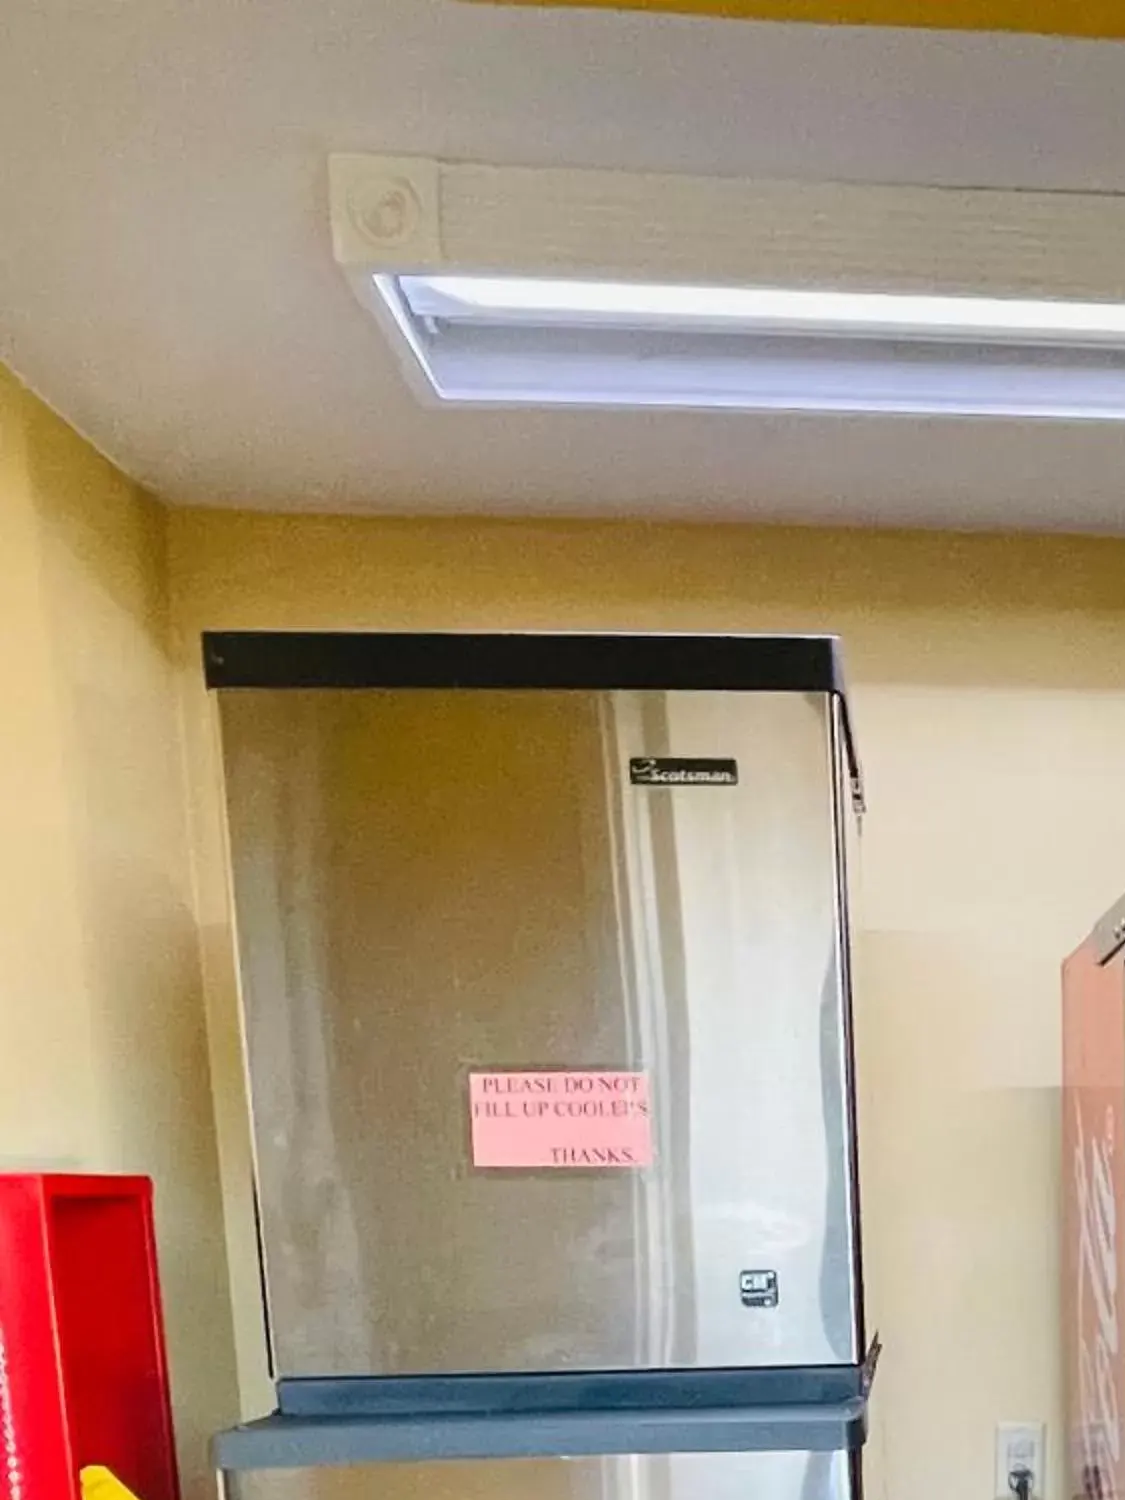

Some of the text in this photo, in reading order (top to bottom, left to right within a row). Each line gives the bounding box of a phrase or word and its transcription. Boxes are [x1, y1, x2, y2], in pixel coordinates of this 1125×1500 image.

[482, 1075, 641, 1094] PLEASE DO NOT
[474, 1101, 519, 1120] FILL
[522, 1101, 550, 1119] UP
